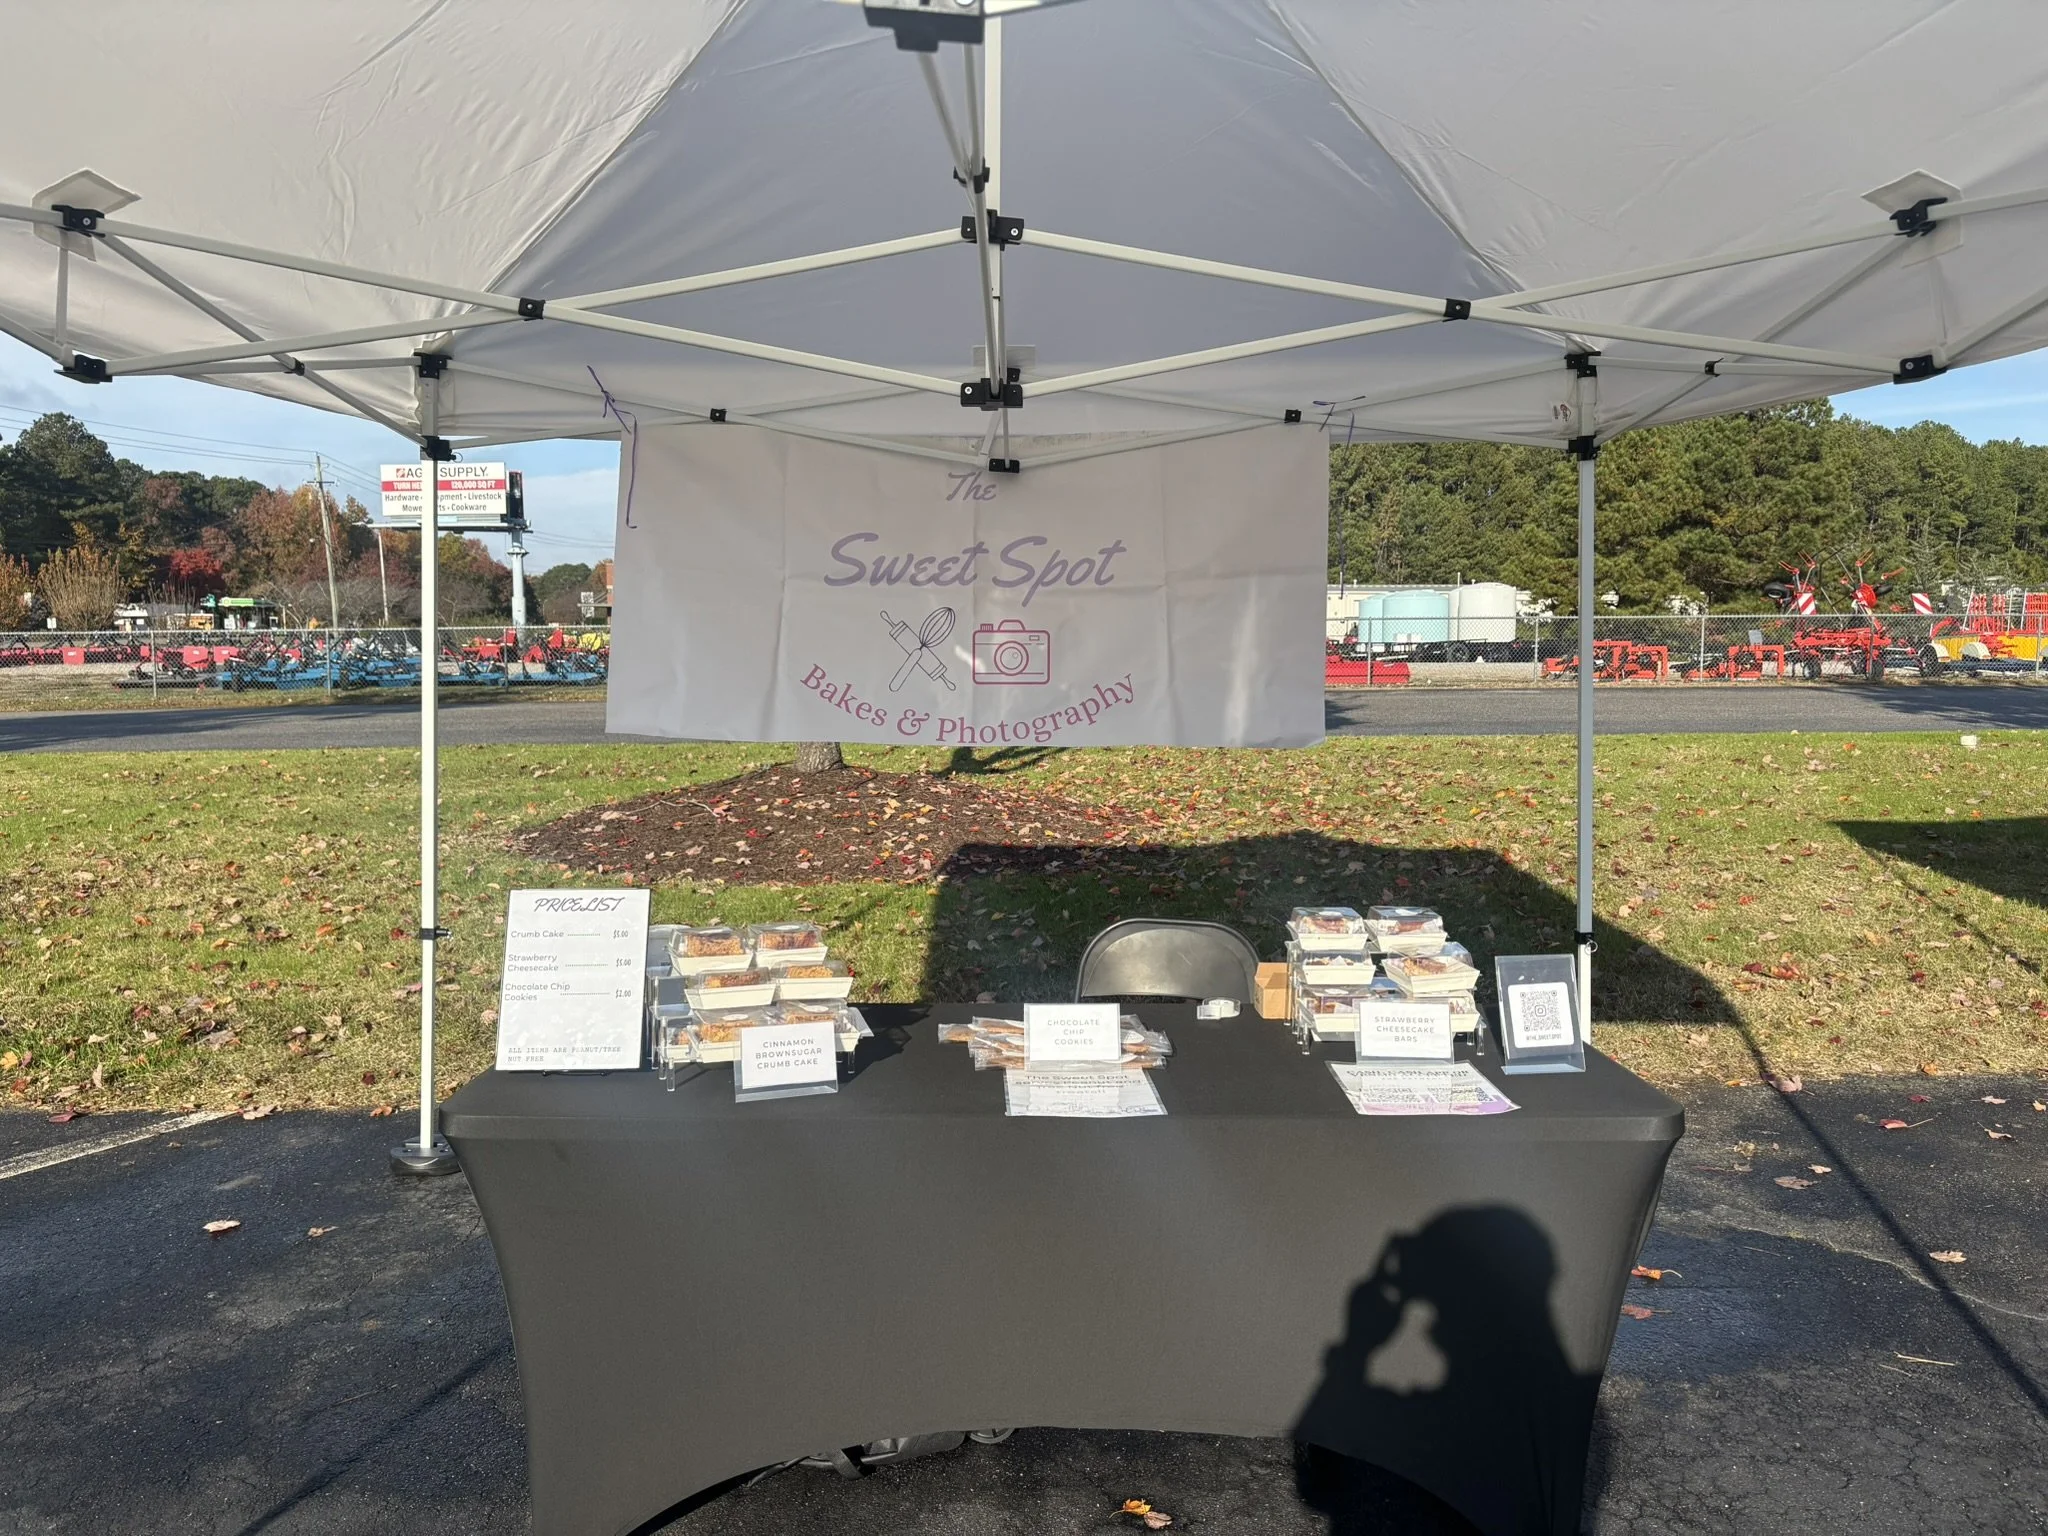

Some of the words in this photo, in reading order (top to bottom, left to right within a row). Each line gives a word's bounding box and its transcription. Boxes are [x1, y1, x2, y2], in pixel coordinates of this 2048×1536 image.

[440, 466, 488, 477] SUPPLY
[393, 482, 410, 491] TURN
[451, 481, 477, 489] 120,000
[477, 481, 487, 489] SQ
[487, 480, 496, 488] FT
[945, 471, 997, 501] The
[385, 494, 419, 502] Hardware
[468, 492, 502, 500] Livestock
[402, 504, 422, 512] Mowe
[451, 503, 487, 511] Cookware
[823, 532, 989, 587] Sweet
[991, 535, 1127, 607] Spot
[800, 664, 888, 727] Bakes
[897, 708, 930, 736] &
[936, 673, 1137, 744] Photography
[511, 930, 540, 938] Crumb
[542, 930, 564, 938] Cake
[508, 954, 558, 962] Strawberry
[507, 964, 559, 972] Cheesecake
[505, 983, 548, 991] Chocolate
[550, 983, 570, 992] Chip
[504, 993, 537, 1001] Cookies
[1376, 1026, 1435, 1034] CHEESECAKE
[763, 1038, 814, 1048] CINNAMON
[1054, 1038, 1094, 1046] COOKIES
[1394, 1035, 1418, 1043] BARS
[756, 1048, 822, 1059] BROWNSUGAR
[757, 1060, 791, 1069] CRUMB
[794, 1058, 818, 1066] CAKE
